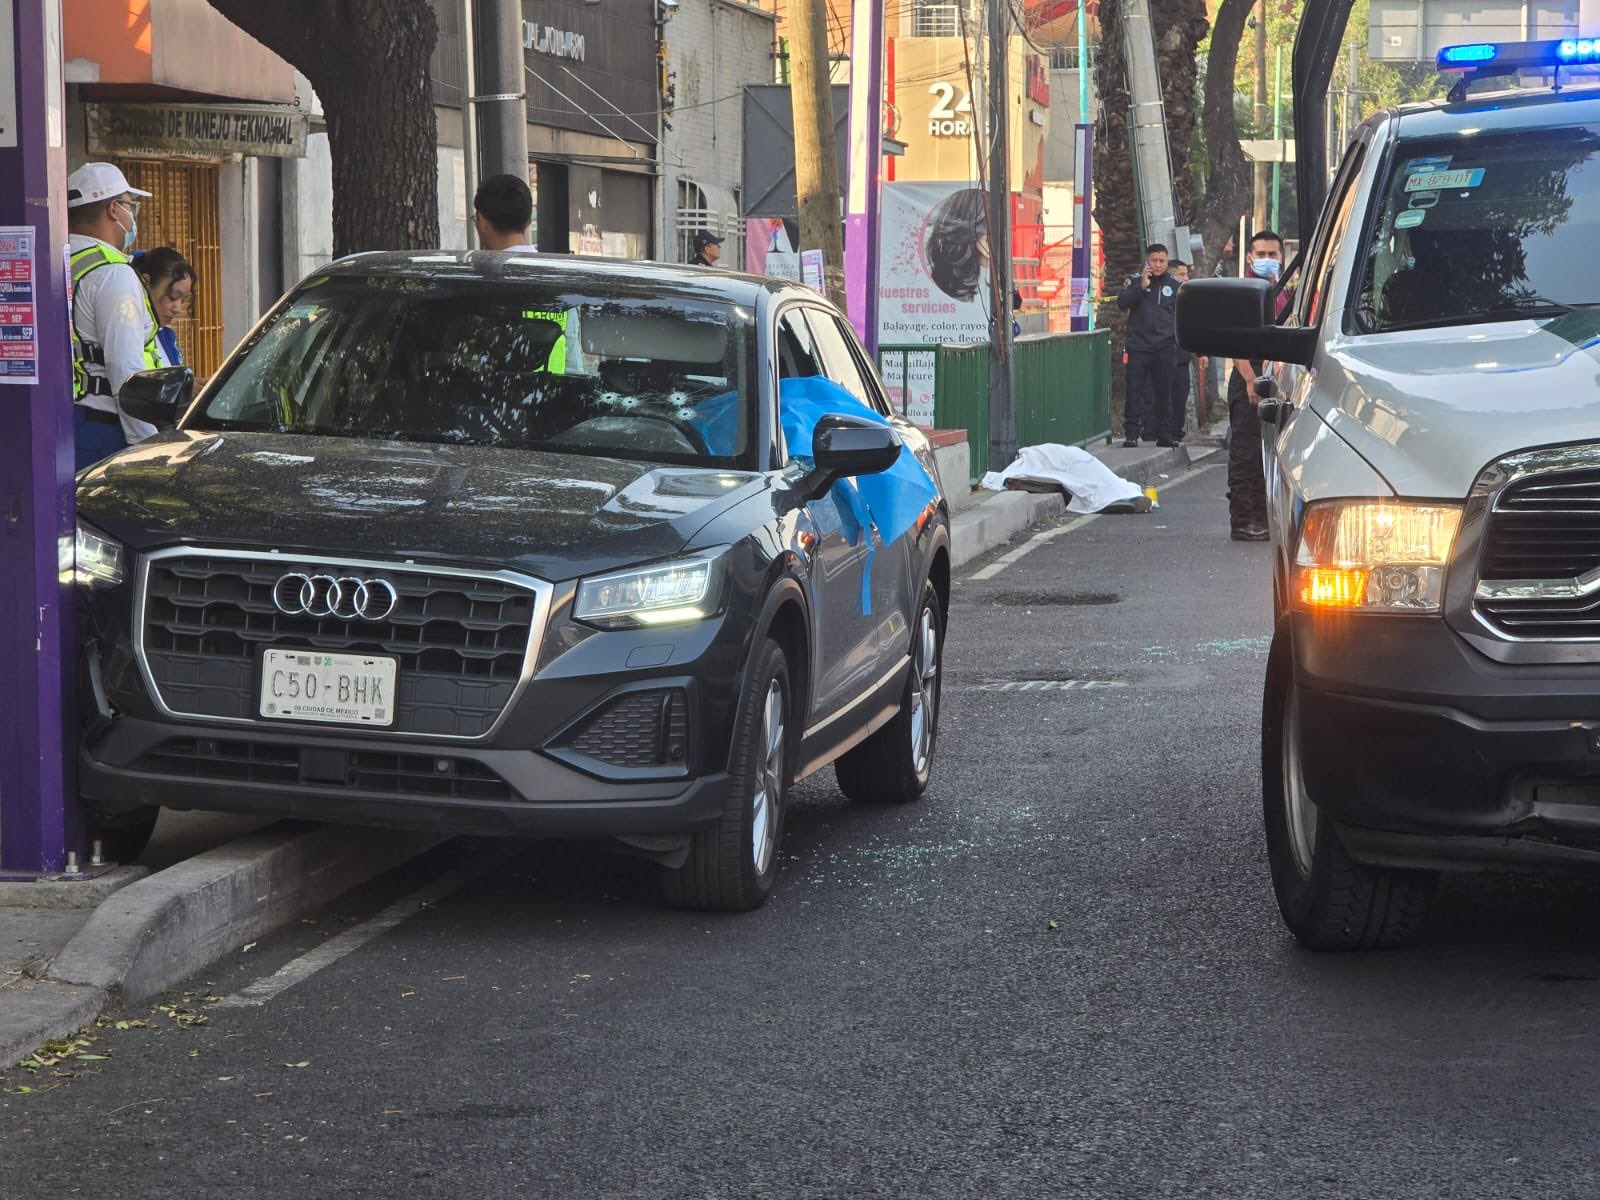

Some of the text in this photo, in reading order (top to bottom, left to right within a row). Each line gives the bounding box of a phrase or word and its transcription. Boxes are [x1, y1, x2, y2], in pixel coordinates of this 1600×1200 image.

[928, 81, 971, 119] 24
[168, 110, 182, 138] DE
[185, 111, 229, 141] MANEJO
[901, 302, 957, 314] servicios
[883, 321, 987, 333] Balayage, color, rayos
[887, 372, 934, 381] Maicure
[270, 653, 277, 663] F
[272, 669, 384, 706] C50-BHK
[302, 705, 325, 713] CIUDAD
